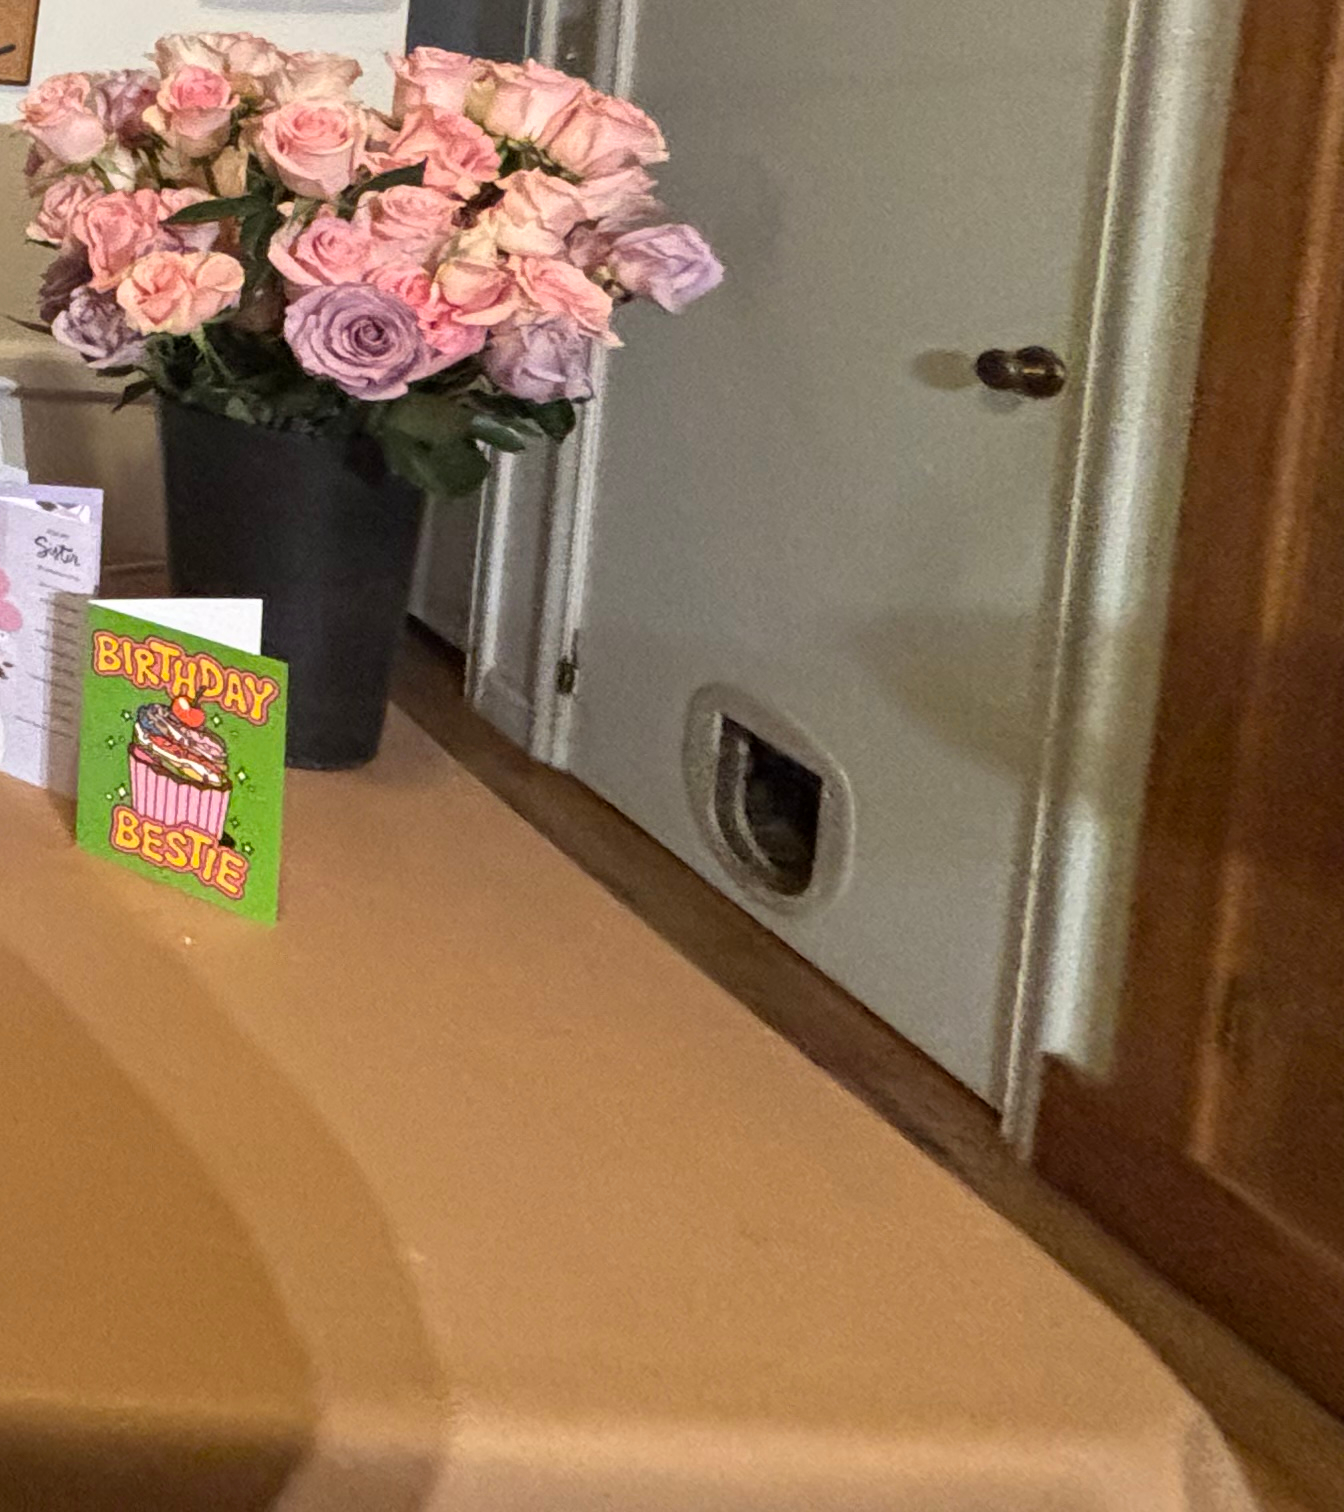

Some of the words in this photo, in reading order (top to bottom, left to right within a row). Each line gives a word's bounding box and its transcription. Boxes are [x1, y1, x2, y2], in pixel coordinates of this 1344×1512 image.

[34, 535, 80, 567] Sister
[95, 634, 277, 723] BIRTHDAY
[114, 809, 247, 896] BESTIE
